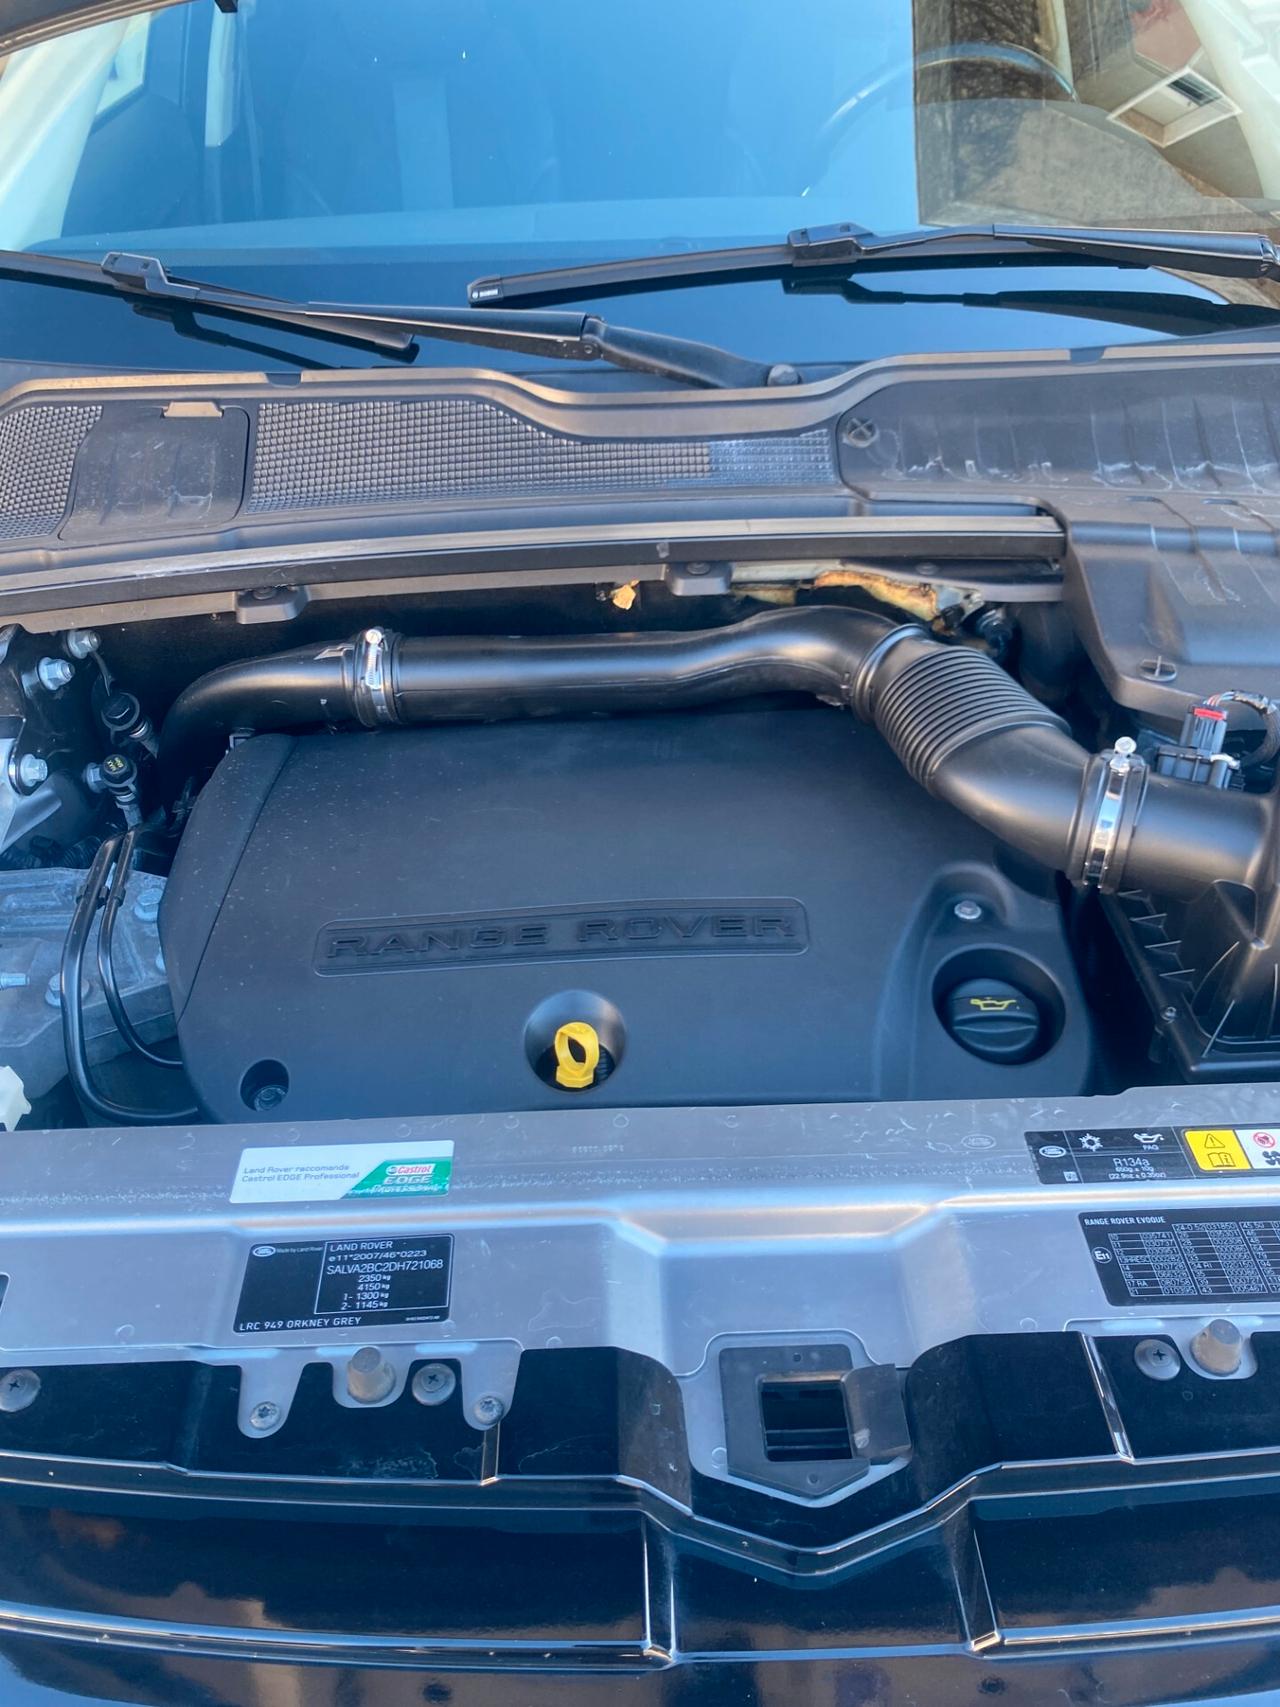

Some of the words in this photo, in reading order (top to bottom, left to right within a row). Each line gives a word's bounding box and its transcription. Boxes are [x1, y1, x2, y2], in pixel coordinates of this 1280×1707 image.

[327, 924, 548, 959] RANGE
[578, 914, 797, 943] ROVER
[1112, 1157, 1150, 1166] R134a
[398, 1165, 432, 1173] Castrol
[304, 1172, 360, 1180] Professional
[384, 1175, 434, 1184] EDGE
[330, 1242, 358, 1252] LAND
[360, 1241, 393, 1250] ROVER
[326, 1259, 443, 1275] SALVA2BC2DH721068
[239, 1322, 261, 1331] LRC
[264, 1320, 283, 1329] 949
[286, 1319, 330, 1328] ORKNEY
[333, 1316, 362, 1326] GREY
